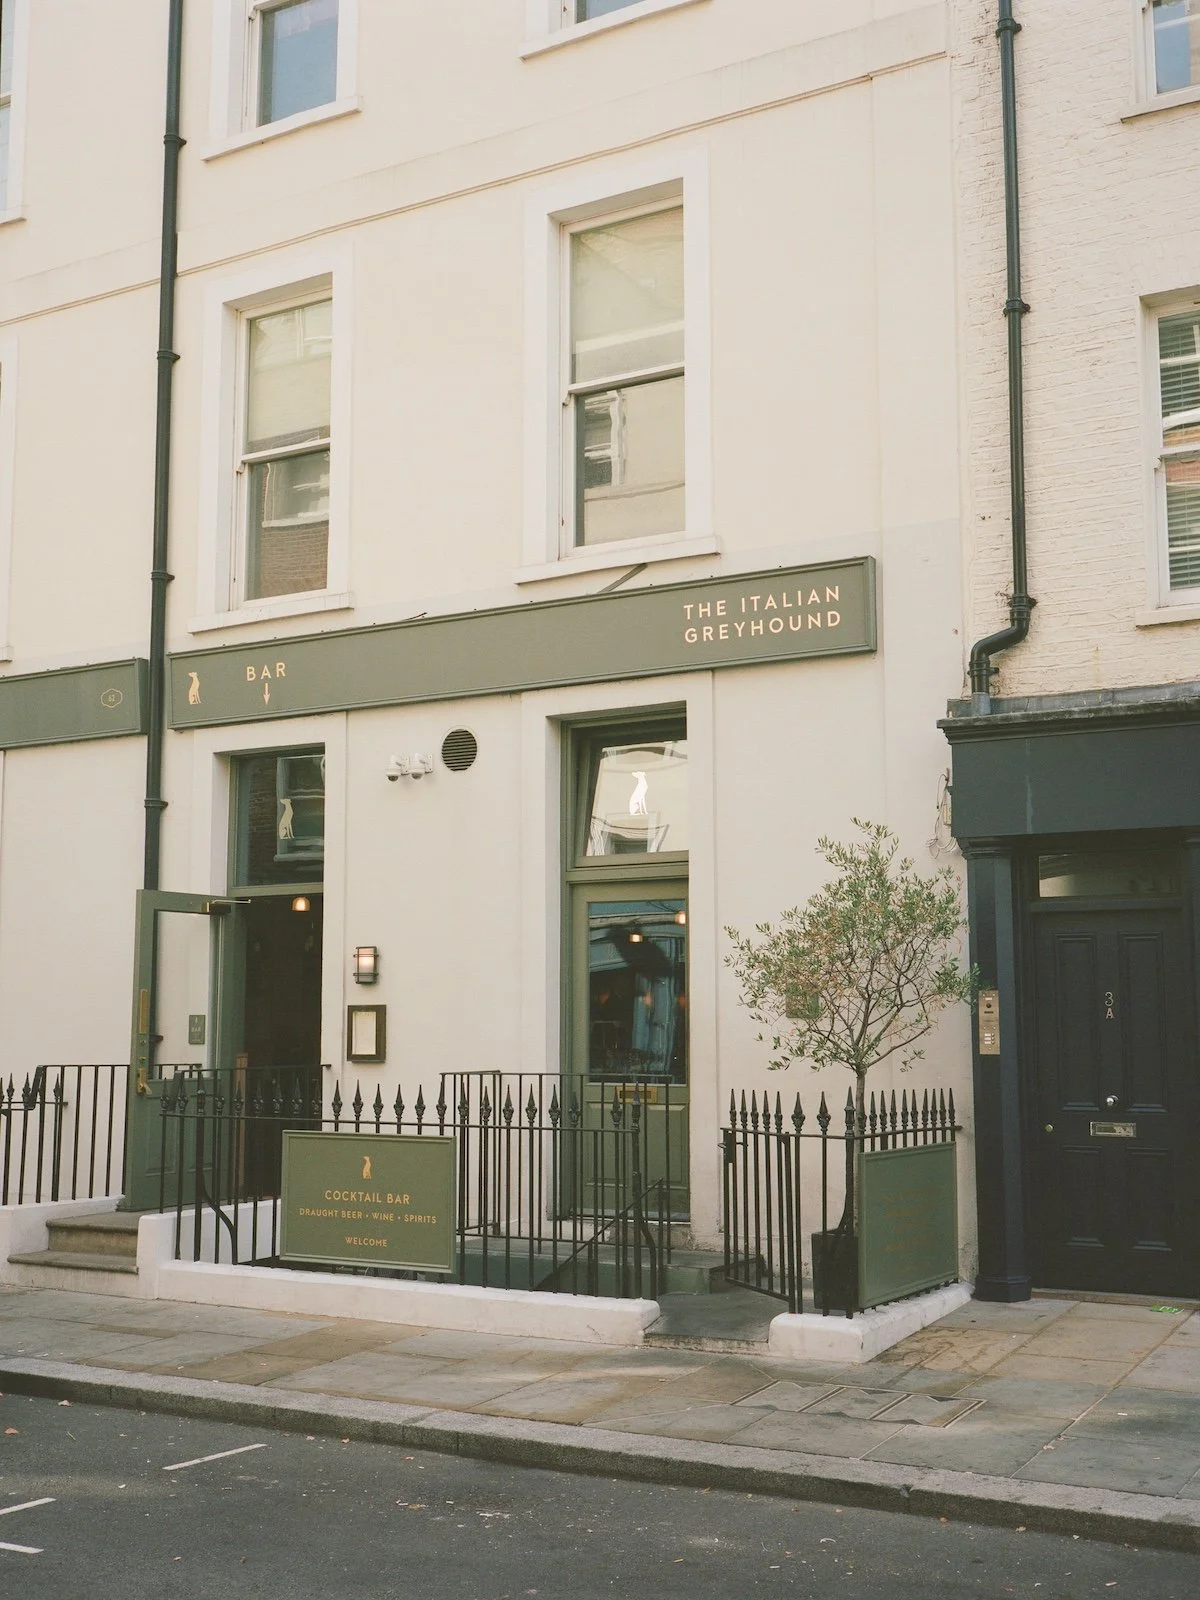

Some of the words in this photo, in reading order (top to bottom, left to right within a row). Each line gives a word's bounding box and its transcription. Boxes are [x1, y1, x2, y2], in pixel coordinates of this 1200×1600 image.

[683, 600, 726, 620] THE
[741, 585, 840, 613] ITALIAN
[684, 610, 841, 644] GREYHOUND
[246, 662, 286, 682] BAR
[324, 1190, 382, 1203] COCKTAIL
[386, 1193, 410, 1205] BAR
[299, 1207, 338, 1218] DRAUGHT
[341, 1210, 362, 1219] BEER
[371, 1212, 394, 1222] WINE
[404, 1214, 437, 1224] SPIRITS
[344, 1236, 388, 1247] WELCOME
